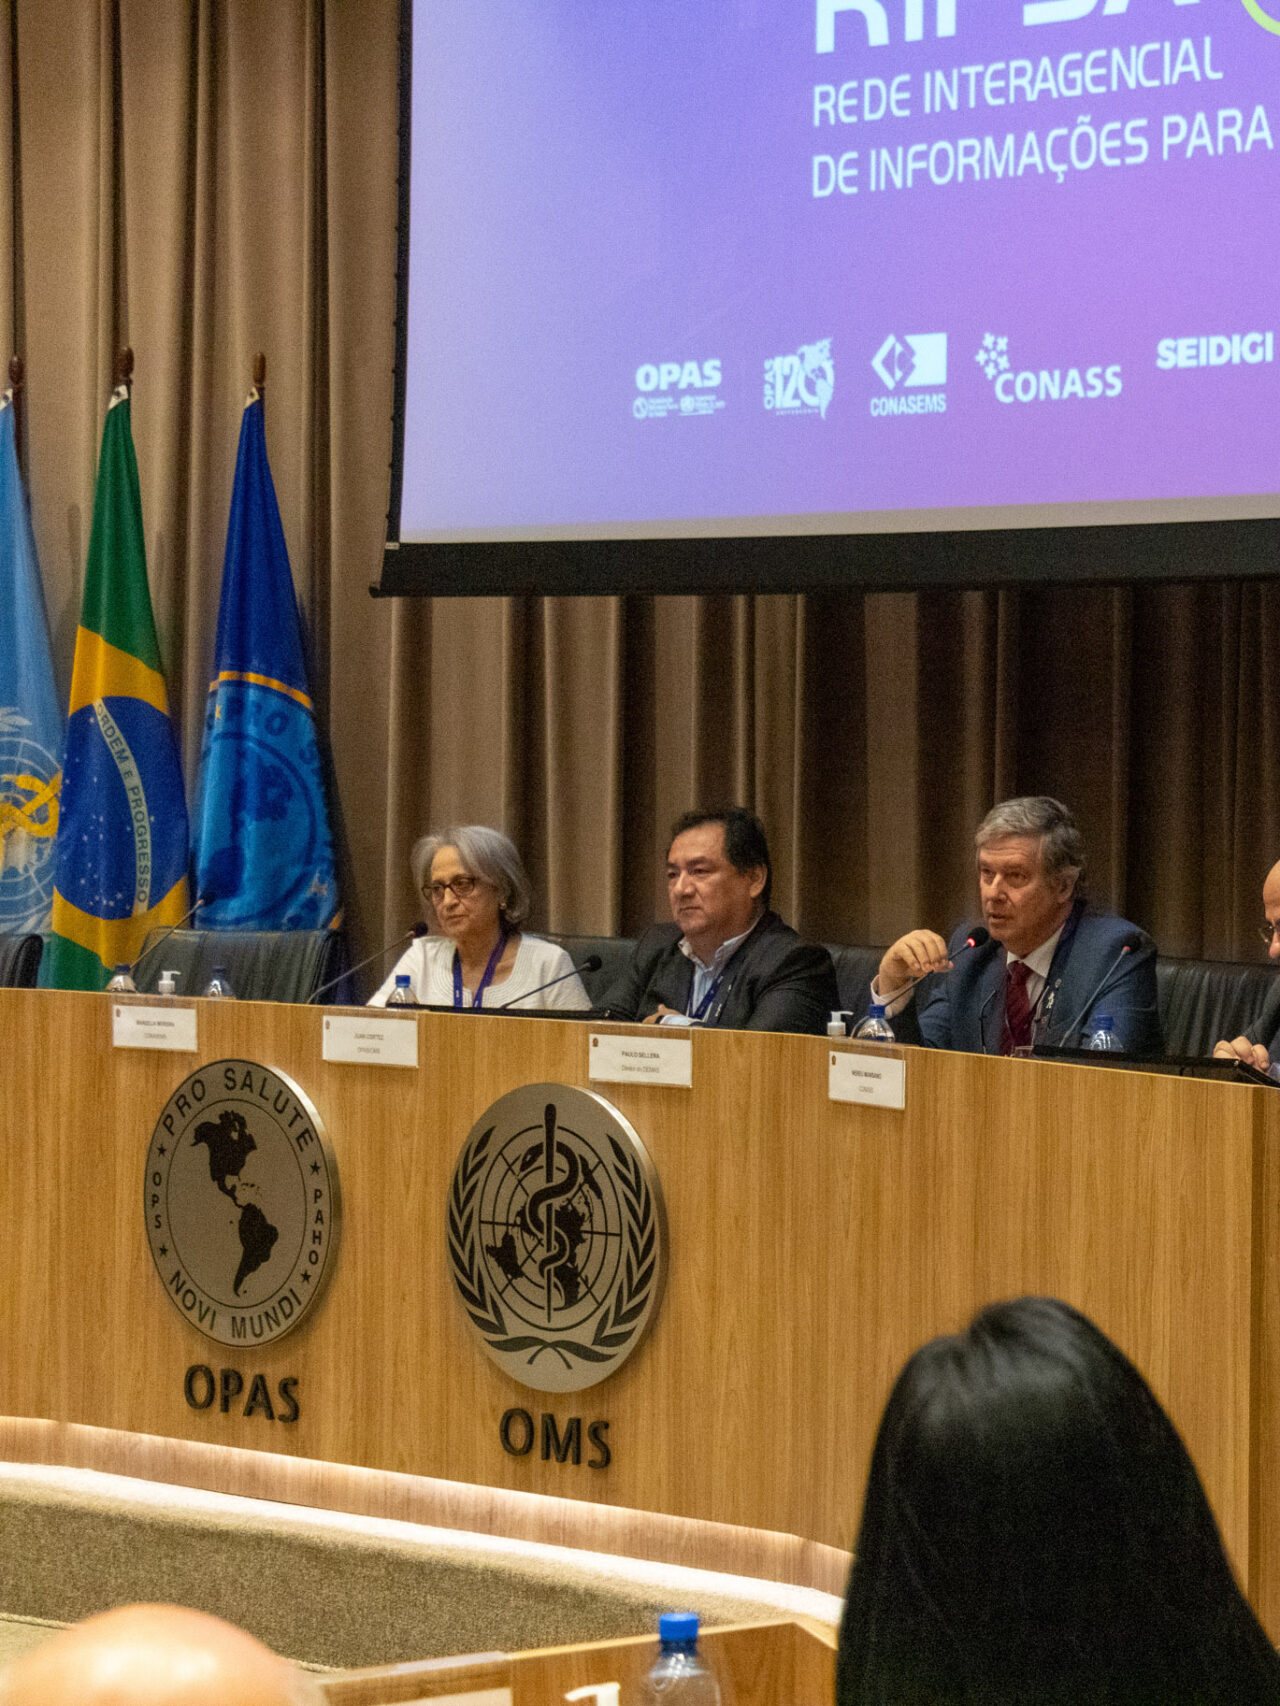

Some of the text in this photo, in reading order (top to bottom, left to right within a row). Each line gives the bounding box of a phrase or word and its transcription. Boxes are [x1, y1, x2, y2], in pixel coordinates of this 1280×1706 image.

[813, 36, 1223, 127] REDE INTERAGENCIAL
[812, 151, 859, 198] DE
[870, 114, 1149, 192] INFORMAÇÕES
[1163, 104, 1273, 161] PARA
[635, 359, 722, 392] OPAS
[1156, 331, 1274, 369] SEIDIGI
[764, 359, 776, 410] OPAS
[870, 393, 946, 418] CONASEMS
[994, 365, 1122, 403] CONASS
[122, 767, 133, 780] E
[128, 784, 150, 904] PROGRESSO
[162, 1067, 314, 1152] PRO SALUTE
[151, 1171, 162, 1229] OPS
[308, 1189, 325, 1266] PAHO
[168, 1270, 302, 1339] NOVI MUNDI
[183, 1363, 299, 1424] OPAS
[500, 1406, 611, 1470] OMS
